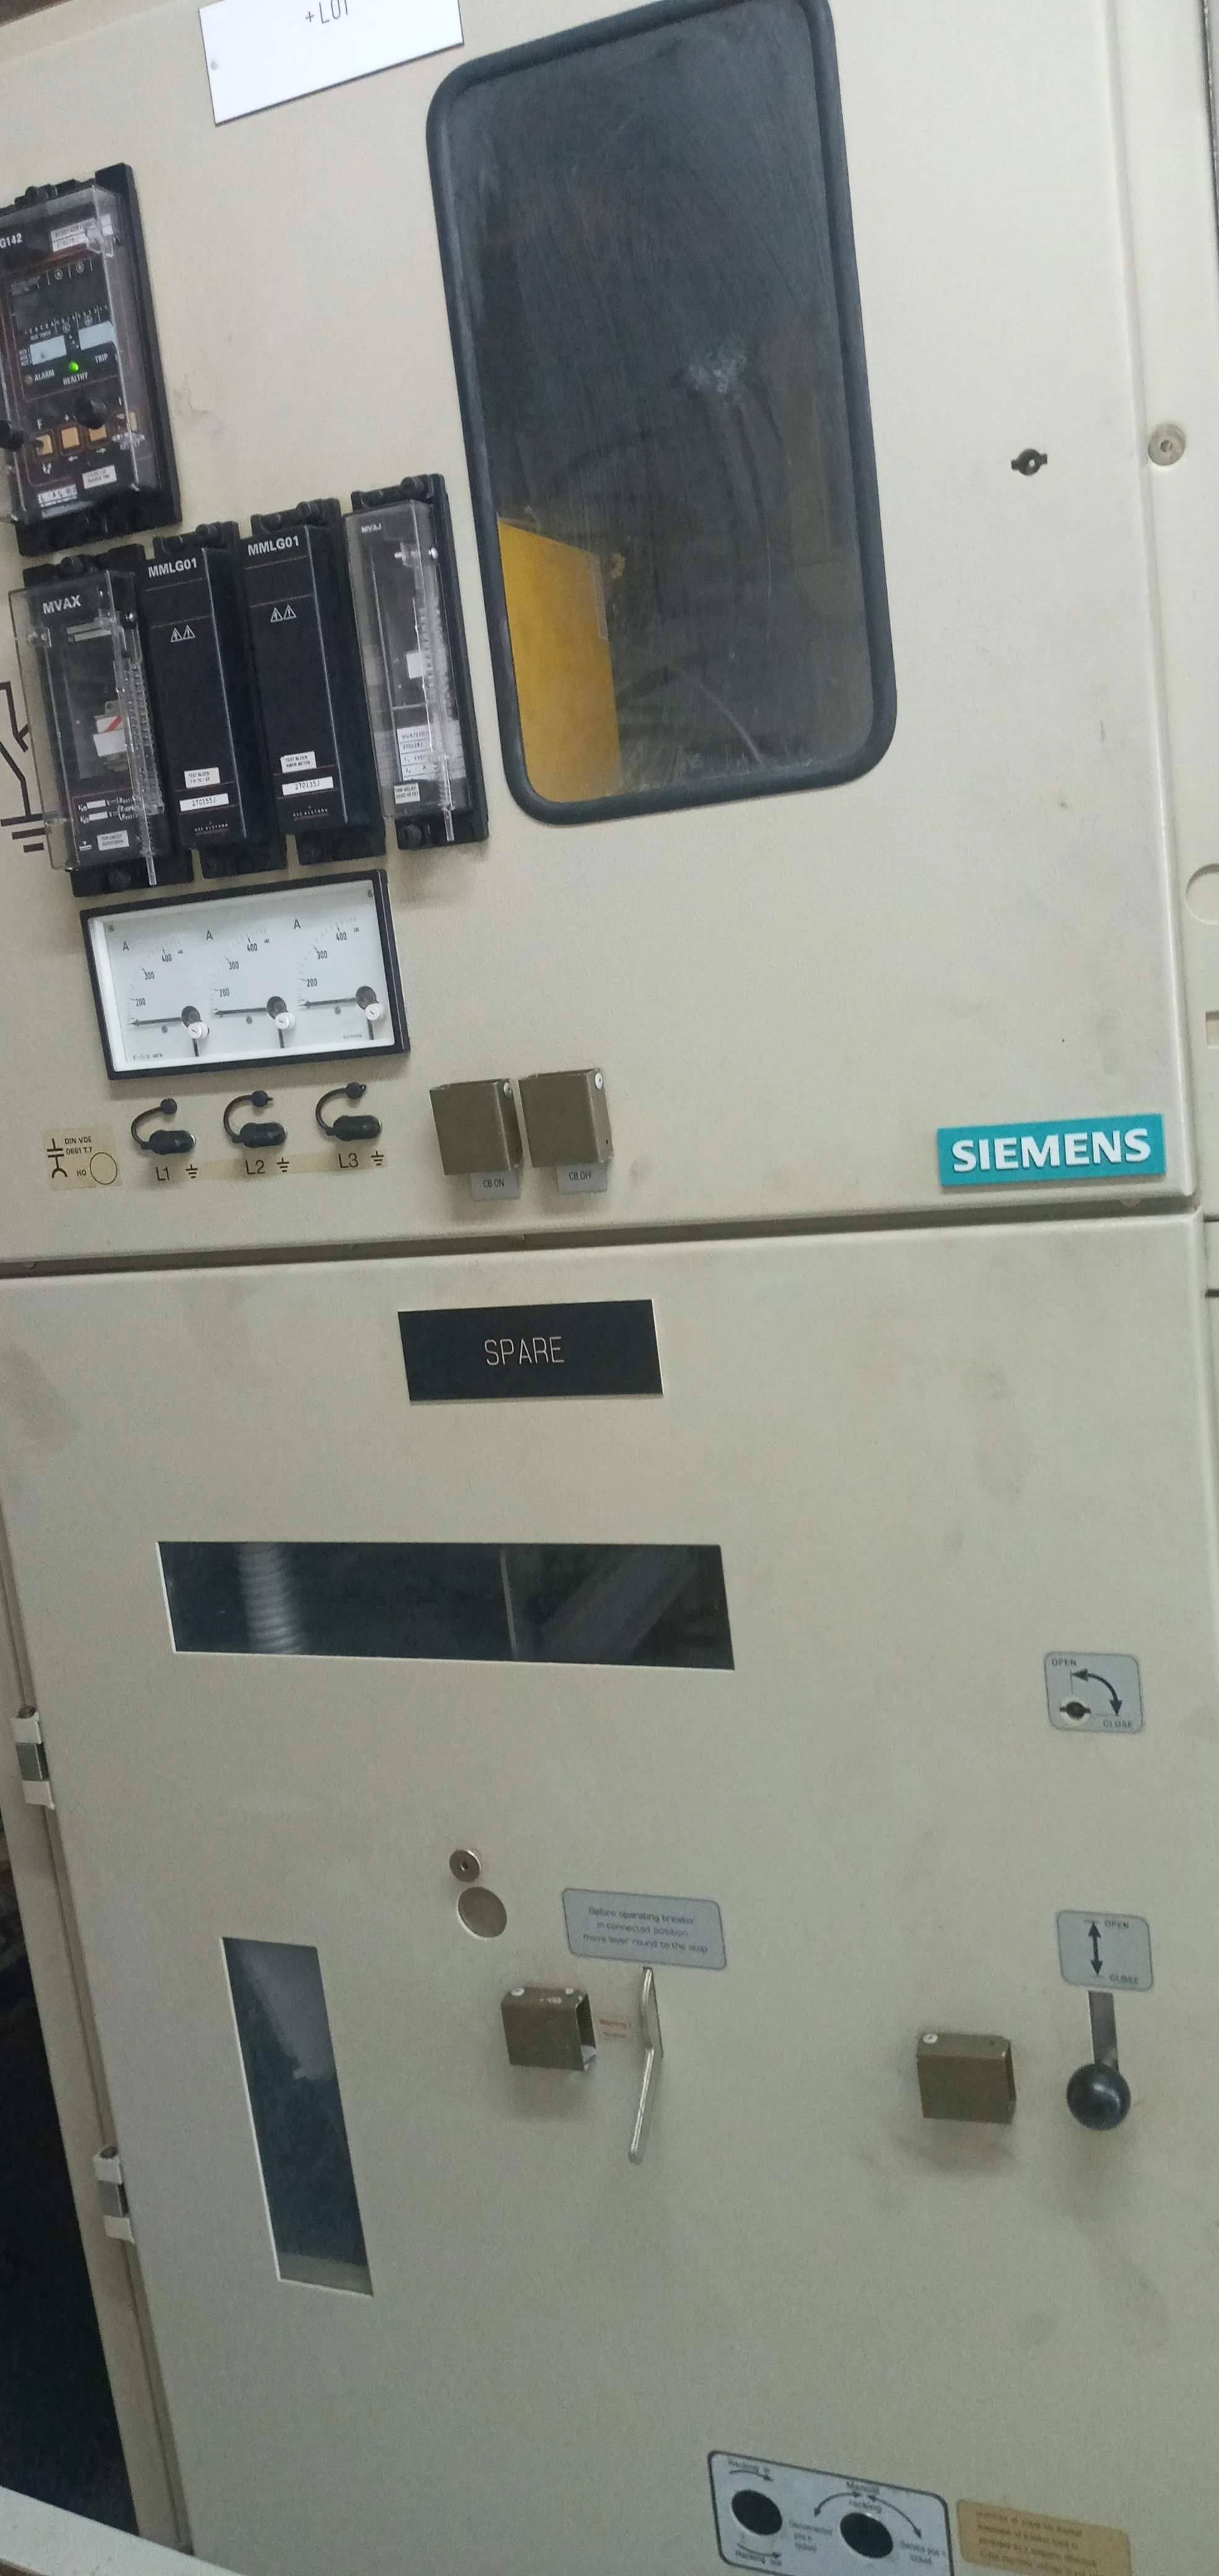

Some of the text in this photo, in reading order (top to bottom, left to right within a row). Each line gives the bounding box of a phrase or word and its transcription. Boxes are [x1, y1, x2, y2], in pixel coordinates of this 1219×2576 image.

[95, 353, 108, 363] TRIP
[35, 369, 55, 381] ALARM
[63, 373, 88, 385] HEALTHY
[248, 535, 299, 556] MMLG01
[148, 557, 197, 578] MMLG01
[43, 594, 81, 614] MVAX
[294, 919, 301, 929] A
[206, 929, 213, 940] A
[336, 932, 347, 941] 400
[123, 941, 129, 951] A
[247, 943, 258, 952] 400
[162, 954, 172, 962] 400
[317, 951, 328, 959] 300
[229, 961, 239, 970] 300
[144, 972, 154, 980] 300
[307, 978, 317, 987] 200
[220, 988, 230, 997] 200
[136, 998, 146, 1006] 200
[952, 1128, 1151, 1172] SIEMENS
[338, 1153, 359, 1168] L3
[245, 1160, 265, 1175] L2
[155, 1167, 170, 1181] L1
[569, 1171, 579, 1180] CB
[483, 1178, 505, 1188] CB ON
[484, 1336, 564, 1366] SPARE
[1052, 1659, 1077, 1667] OPEN
[1103, 1720, 1132, 1728] CLOSE
[1104, 1920, 1129, 1930] OPEN
[1109, 1973, 1138, 1985] CLOSE
